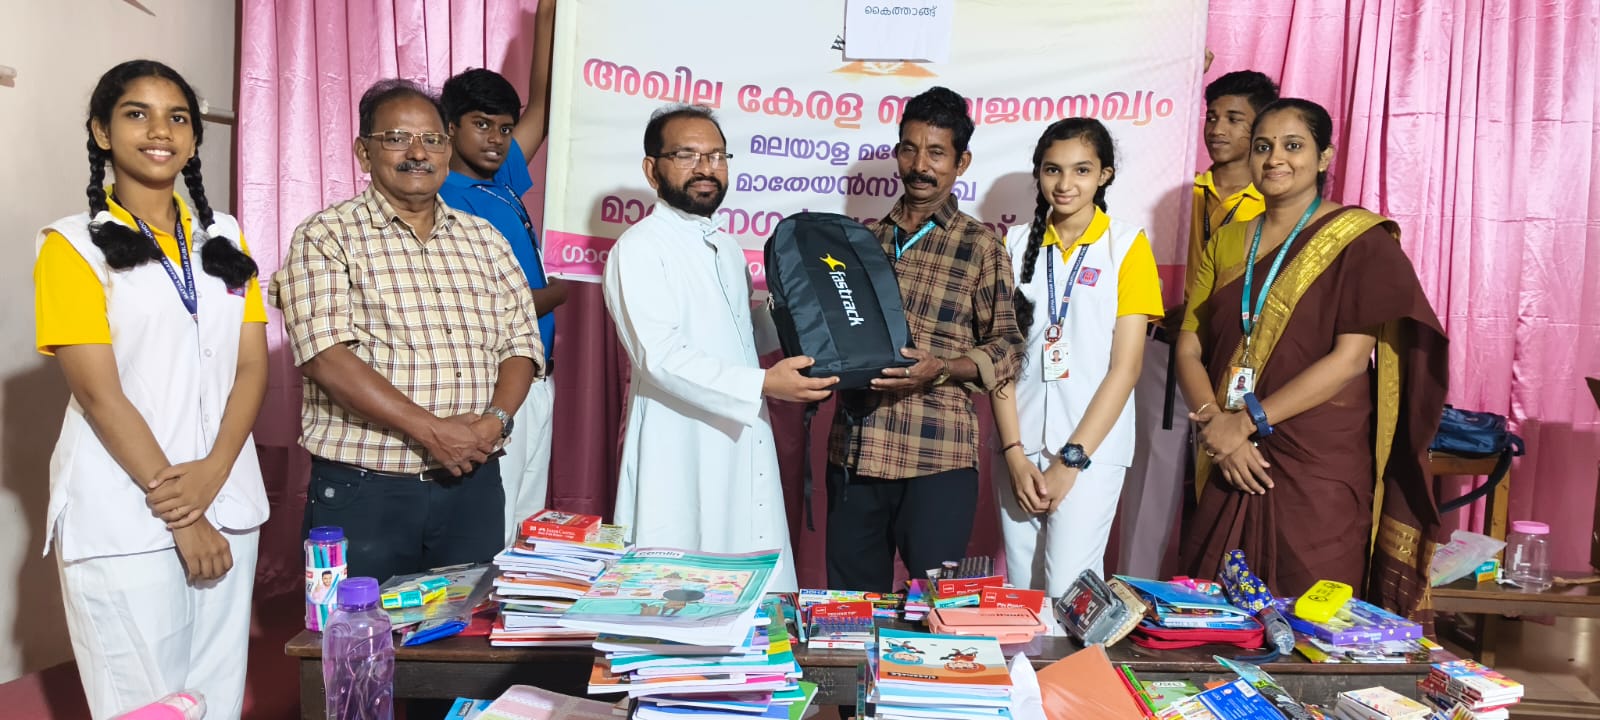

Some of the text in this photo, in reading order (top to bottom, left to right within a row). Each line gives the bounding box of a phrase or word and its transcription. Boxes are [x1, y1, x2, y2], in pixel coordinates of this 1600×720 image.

[583, 58, 723, 109] അഖില
[738, 84, 864, 129] കേരള
[750, 134, 850, 164] മലയാള
[829, 271, 865, 326] fastrack
